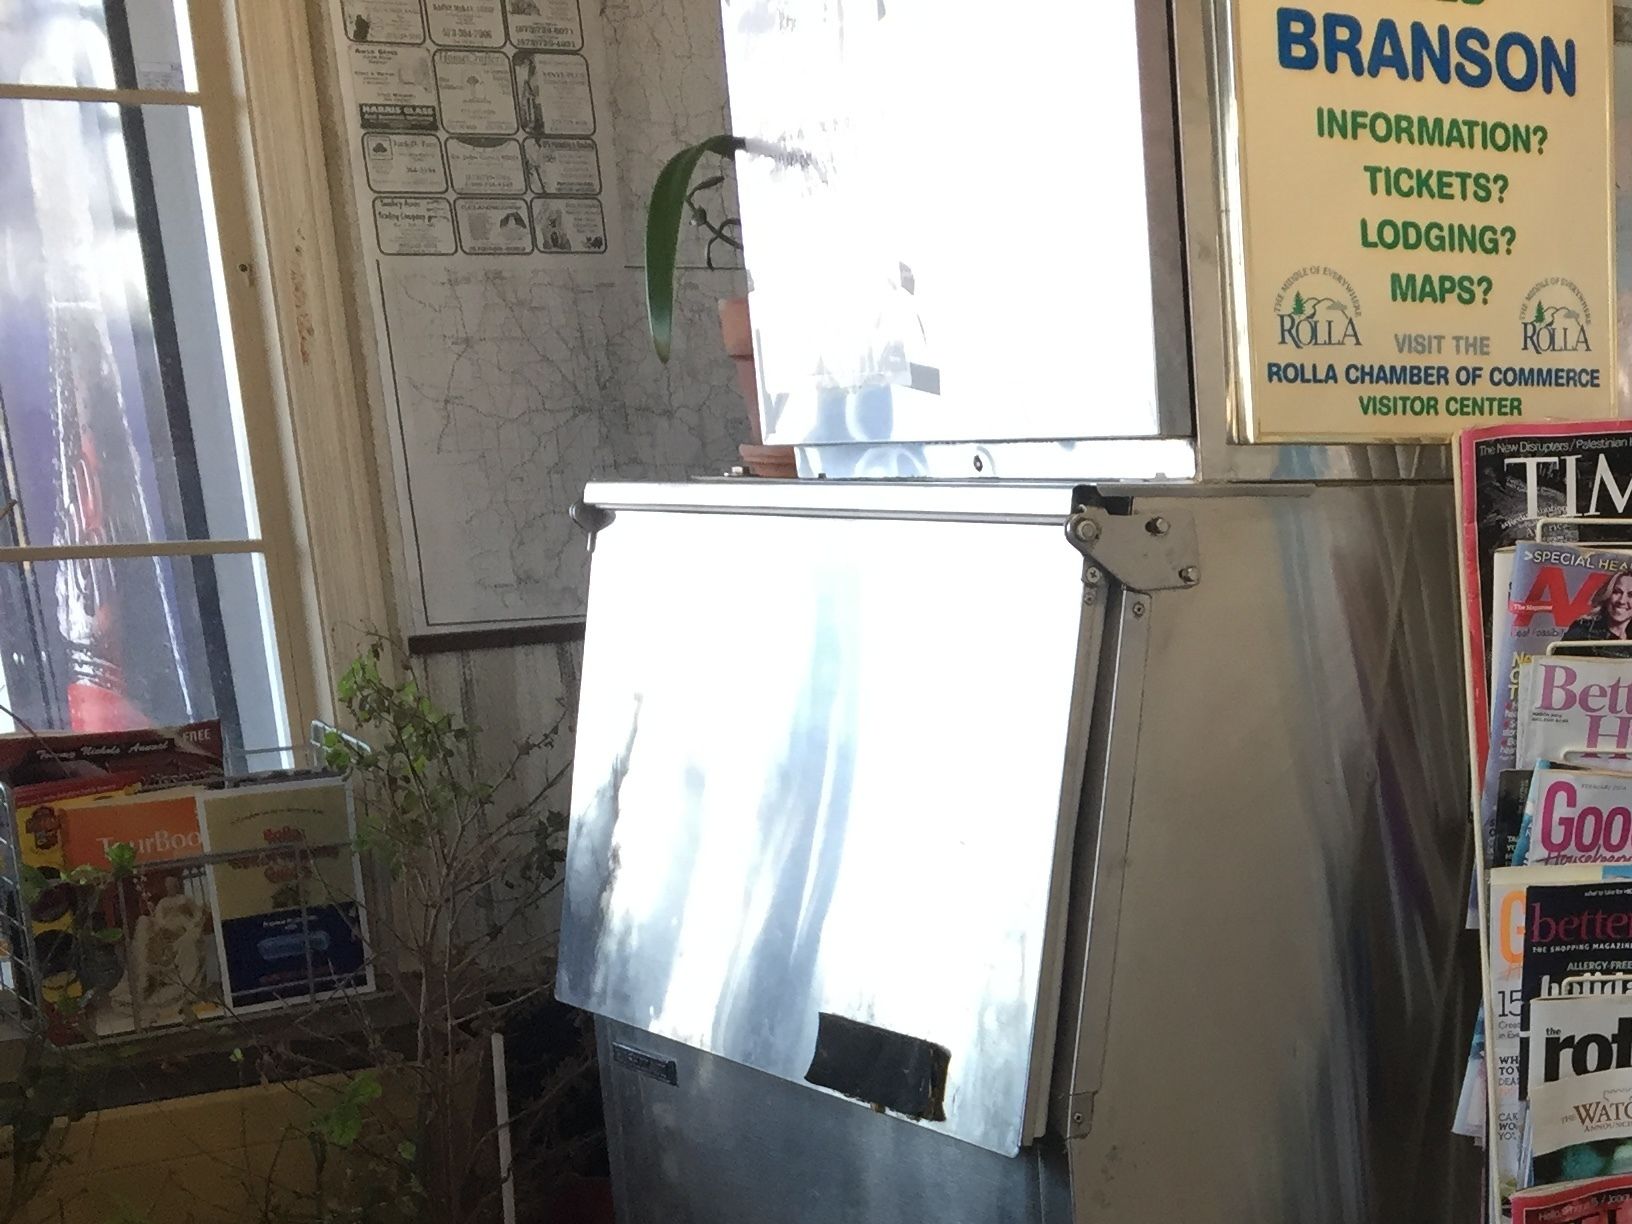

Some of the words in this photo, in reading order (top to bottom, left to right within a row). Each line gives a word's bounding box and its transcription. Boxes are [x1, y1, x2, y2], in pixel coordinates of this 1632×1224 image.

[1275, 6, 1577, 97] BRANSON
[1316, 105, 1549, 155] INFORMATION?
[1363, 164, 1509, 203] TICKETS?
[1360, 217, 1517, 256] LODGING?
[1281, 268, 1310, 295] MIDDLE
[1322, 266, 1362, 318] EVERYWHERE
[1390, 272, 1493, 306] MAPS?
[1277, 312, 1363, 350] ROLLA
[1394, 333, 1445, 355] VISIT
[1452, 335, 1491, 356] THE
[1521, 321, 1593, 355] ROLLA
[1267, 362, 1339, 385] ROLLA
[1344, 363, 1450, 387] CHAMBER
[1455, 365, 1483, 387] OF
[1489, 366, 1601, 388] COMMERCE
[1358, 395, 1440, 416] VISITOR
[1445, 396, 1523, 416] CENTER
[1479, 445, 1496, 456] The
[1532, 550, 1595, 570] SPECIAL
[1545, 1027, 1562, 1038] the
